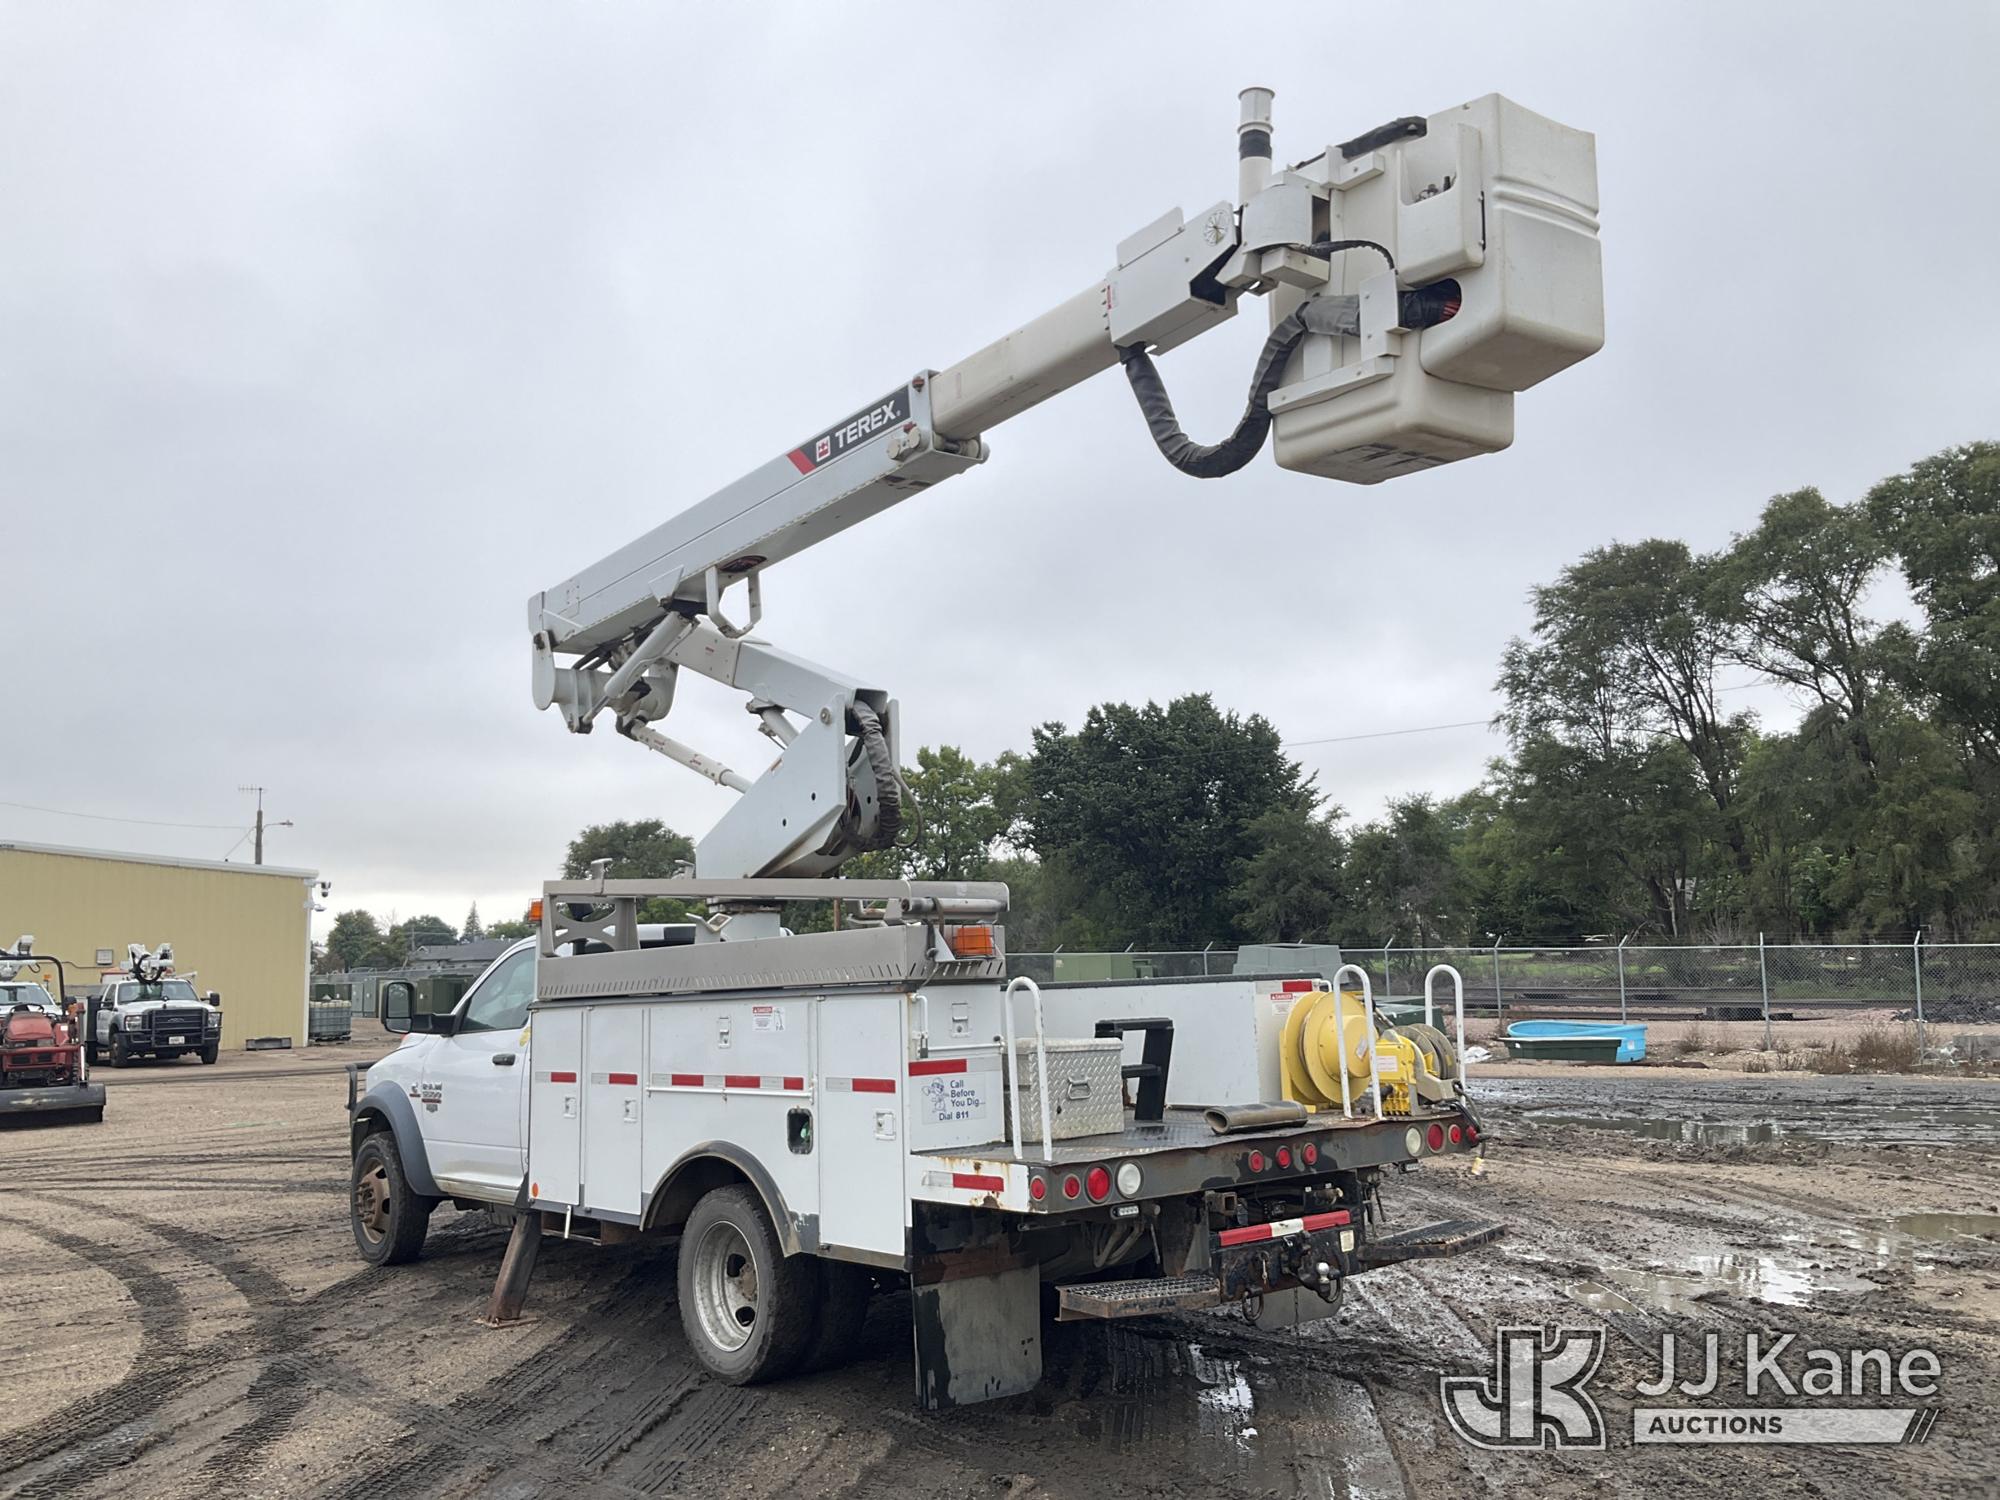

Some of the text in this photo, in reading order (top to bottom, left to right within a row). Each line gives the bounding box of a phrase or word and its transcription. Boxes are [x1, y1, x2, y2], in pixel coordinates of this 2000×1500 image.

[835, 400, 896, 448] TEREX
[950, 1080, 964, 1088] Call
[950, 1089, 975, 1098] Before
[950, 1099, 966, 1107] You
[939, 1111, 969, 1120] Dial 811
